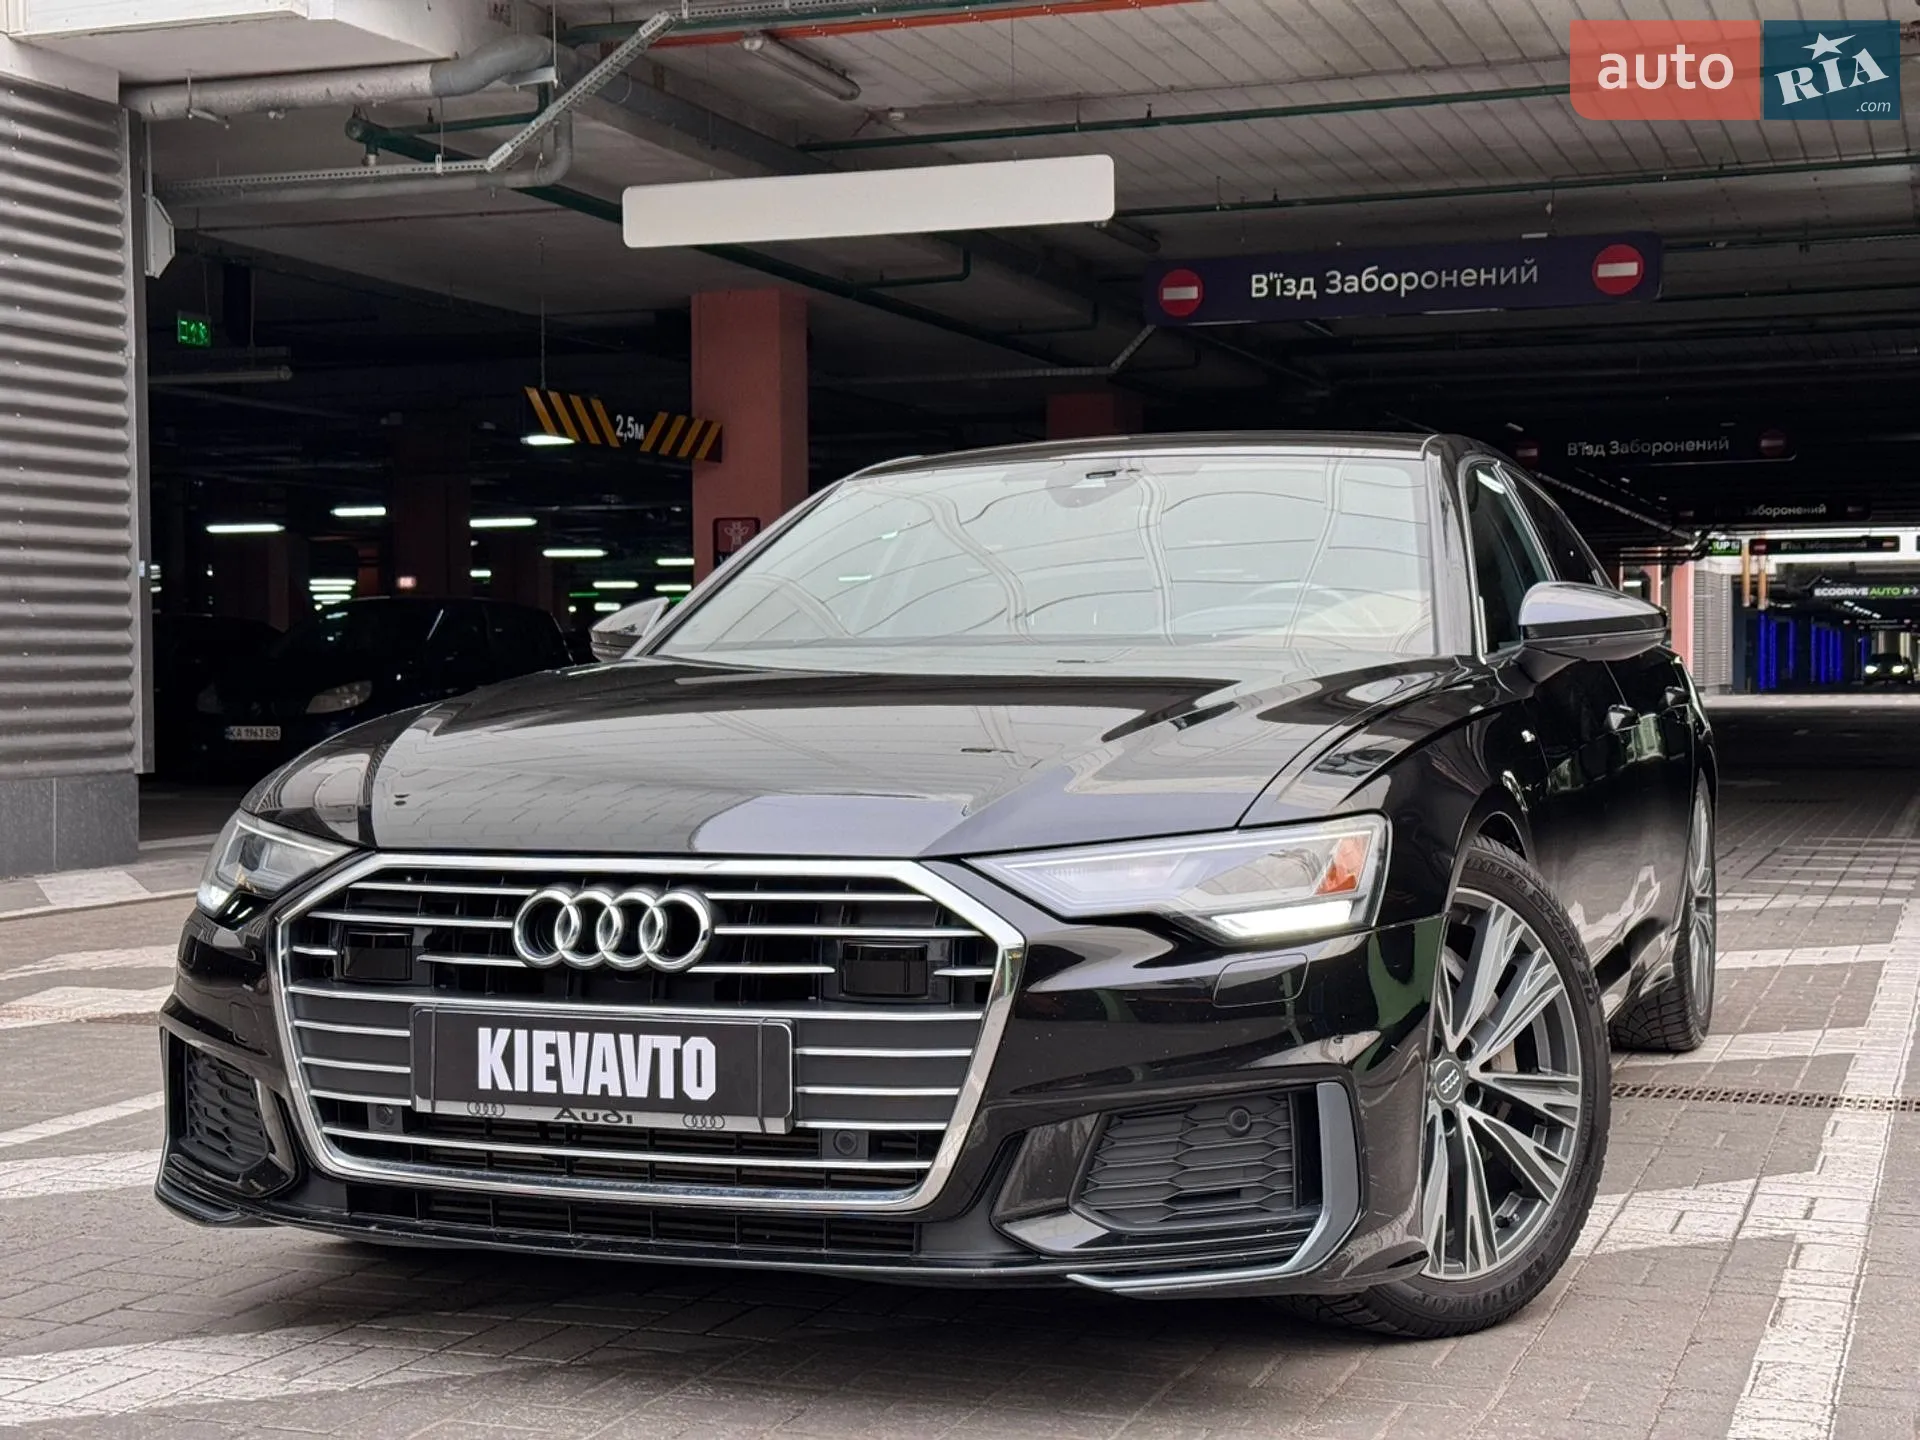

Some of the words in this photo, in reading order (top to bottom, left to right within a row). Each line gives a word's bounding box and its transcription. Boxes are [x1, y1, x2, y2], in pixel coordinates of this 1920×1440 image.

[1251, 271, 1317, 300] В'їзд
[1325, 258, 1539, 297] Заборонений
[1609, 436, 1731, 457] Заборонений
[1814, 586, 1868, 597] ECODRIVE
[1870, 586, 1901, 596] AUTO
[478, 1026, 717, 1101] KIEVAVTO
[554, 1106, 634, 1125] Audi
